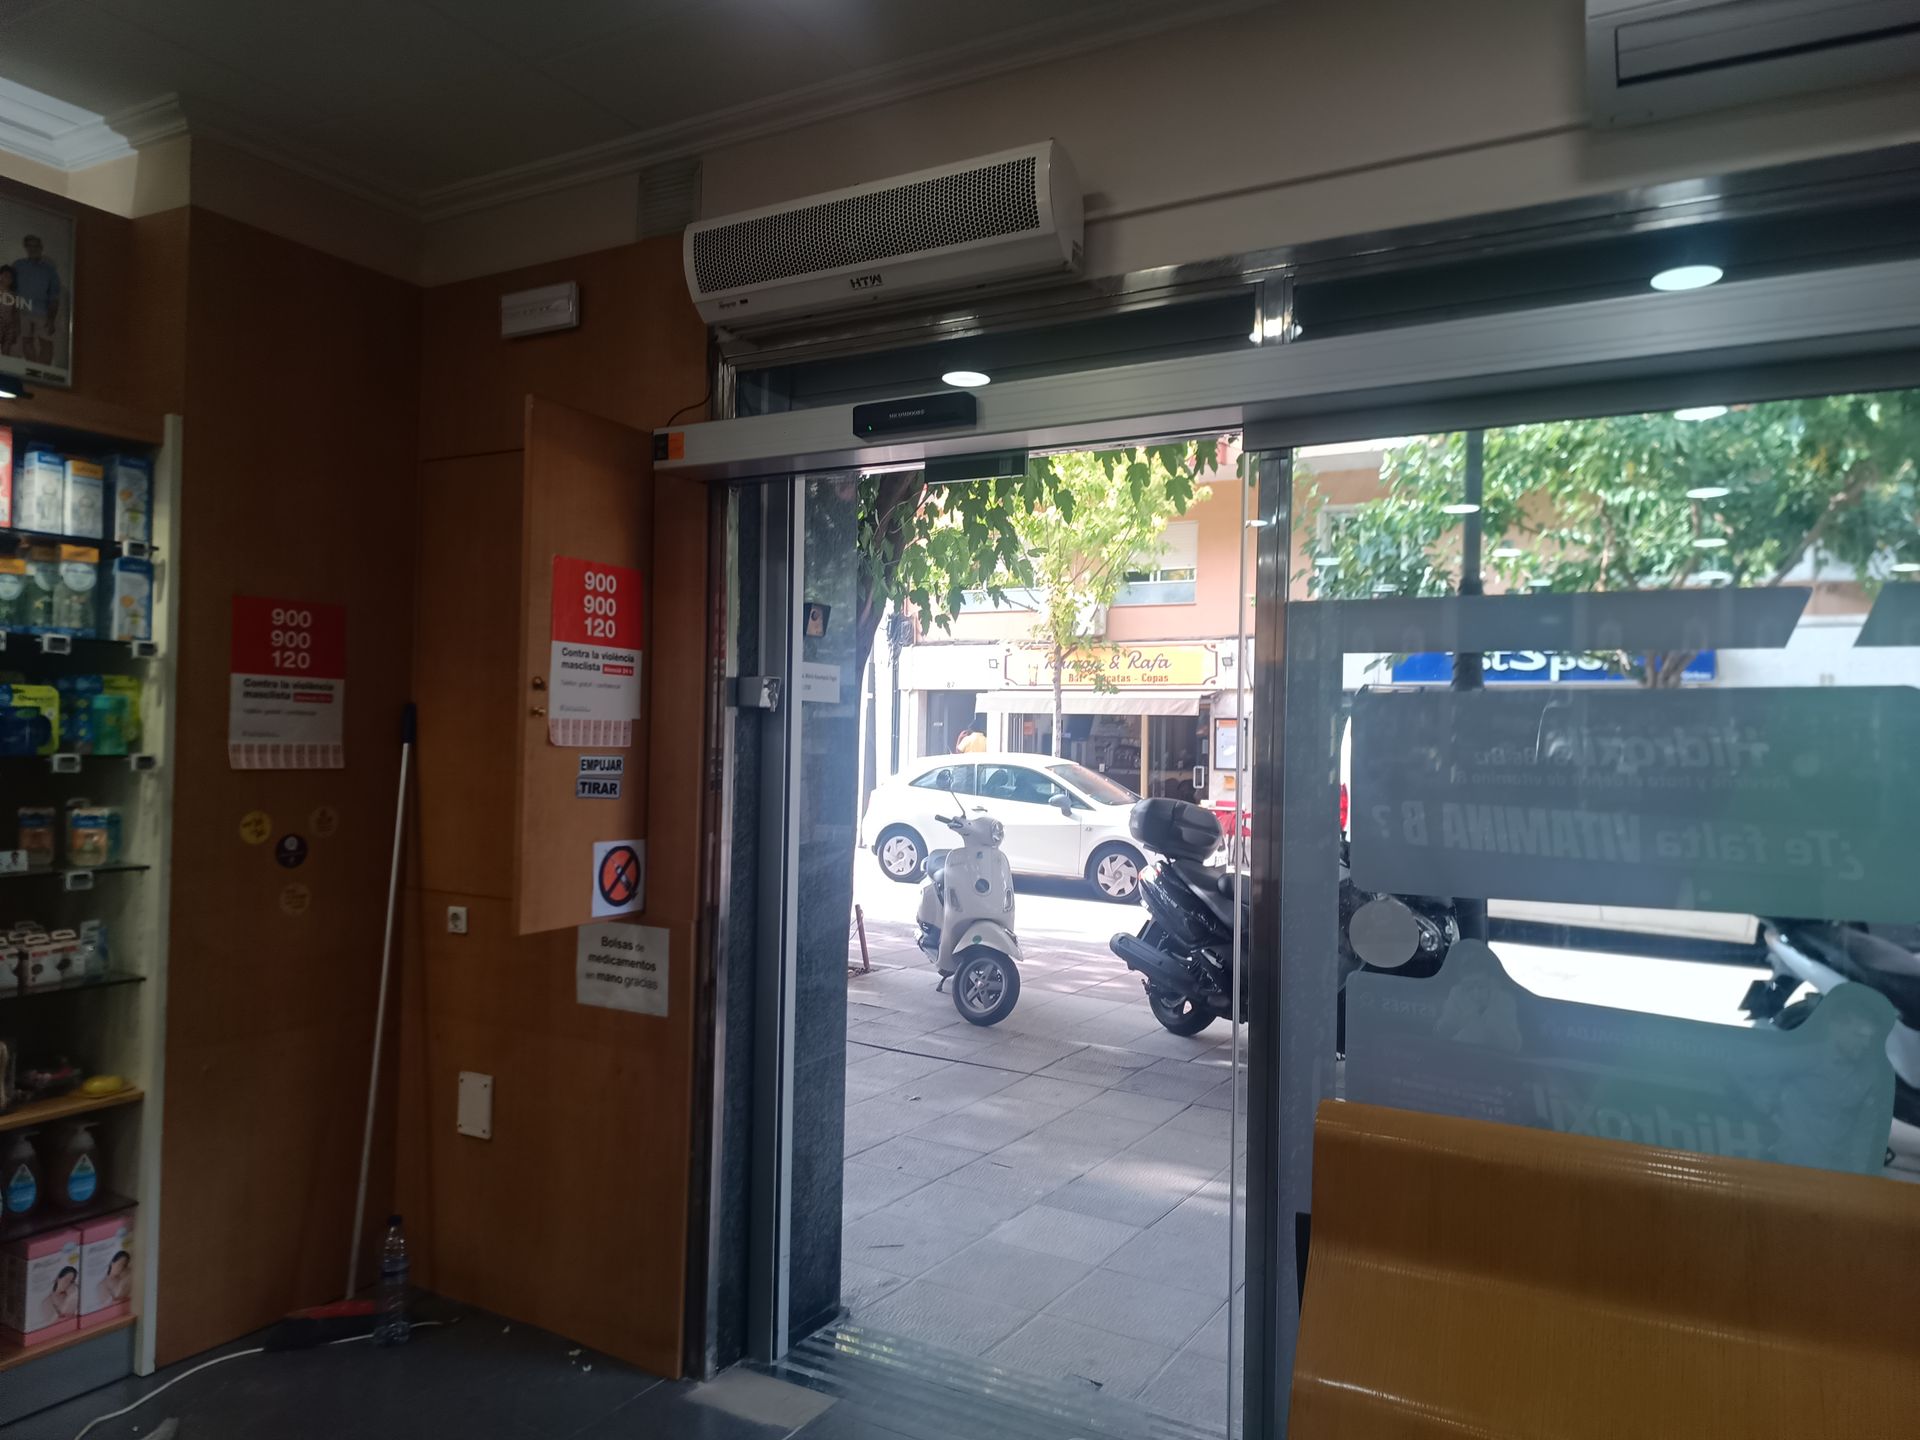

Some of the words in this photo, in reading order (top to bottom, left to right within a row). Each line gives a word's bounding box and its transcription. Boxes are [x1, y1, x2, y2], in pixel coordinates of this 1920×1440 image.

[584, 571, 617, 593] 900
[584, 595, 617, 616] 900
[271, 608, 312, 628] 900
[584, 618, 617, 638] 120
[270, 630, 311, 649] 900
[271, 650, 311, 669] 120
[562, 648, 590, 658] Contra
[592, 650, 599, 659] la
[1109, 655, 1120, 669] &
[1127, 650, 1172, 671] Rafa
[243, 678, 277, 688] Contra
[280, 680, 290, 689] la
[1142, 673, 1169, 683] Copas
[580, 758, 623, 772] EMPUJAR
[580, 782, 617, 795] TIRAR
[601, 936, 633, 950] Bolsas
[588, 954, 656, 972] medicamentos
[597, 973, 623, 984] mano
